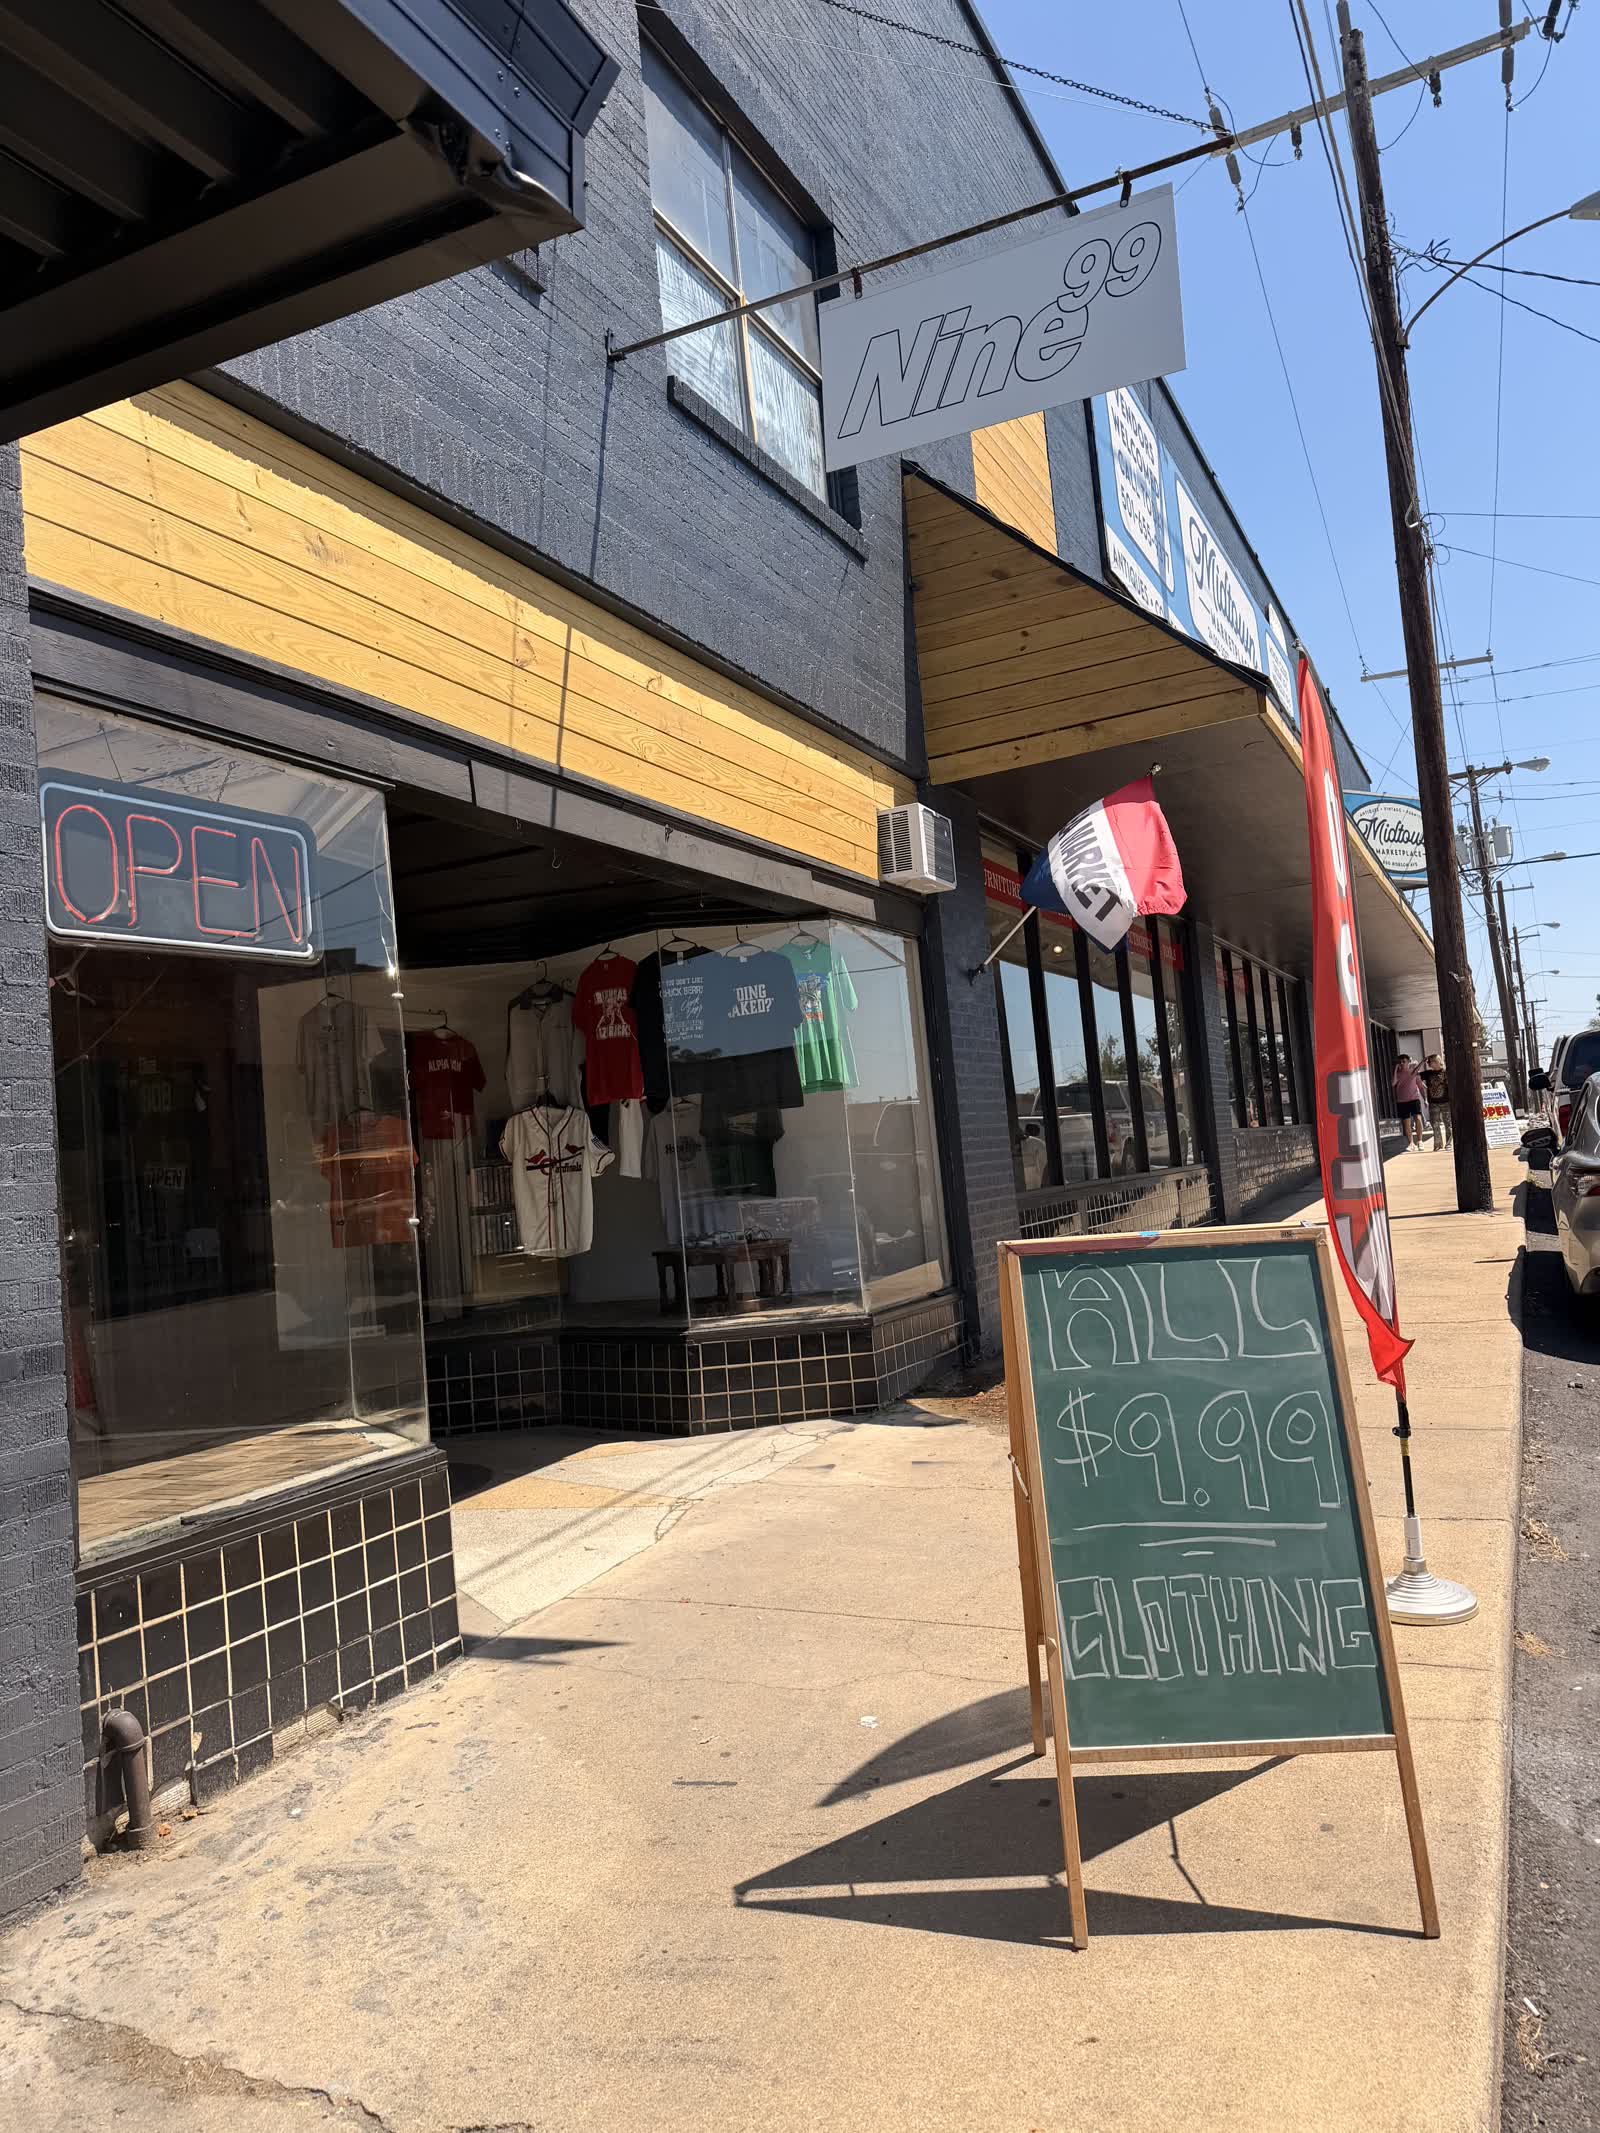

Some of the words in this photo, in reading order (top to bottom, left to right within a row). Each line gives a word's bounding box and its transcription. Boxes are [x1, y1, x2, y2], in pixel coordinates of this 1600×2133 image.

[1110, 405, 1160, 498] WELCOMED
[1114, 389, 1155, 466] VENDORS
[1118, 449, 1141, 500] CALL
[1113, 544, 1150, 605] ANTIQUES
[1189, 516, 1259, 670] Midtown
[54, 804, 303, 943] OPEN
[1060, 820, 1123, 922] MARKET
[1357, 817, 1425, 846] Midtow
[736, 984, 767, 1001] DING
[1481, 1105, 1511, 1118] OPEN
[1039, 1258, 1322, 1372] ALL
[1053, 1386, 1343, 1511] $9.99
[1056, 1575, 1376, 1681] CLOTHING
